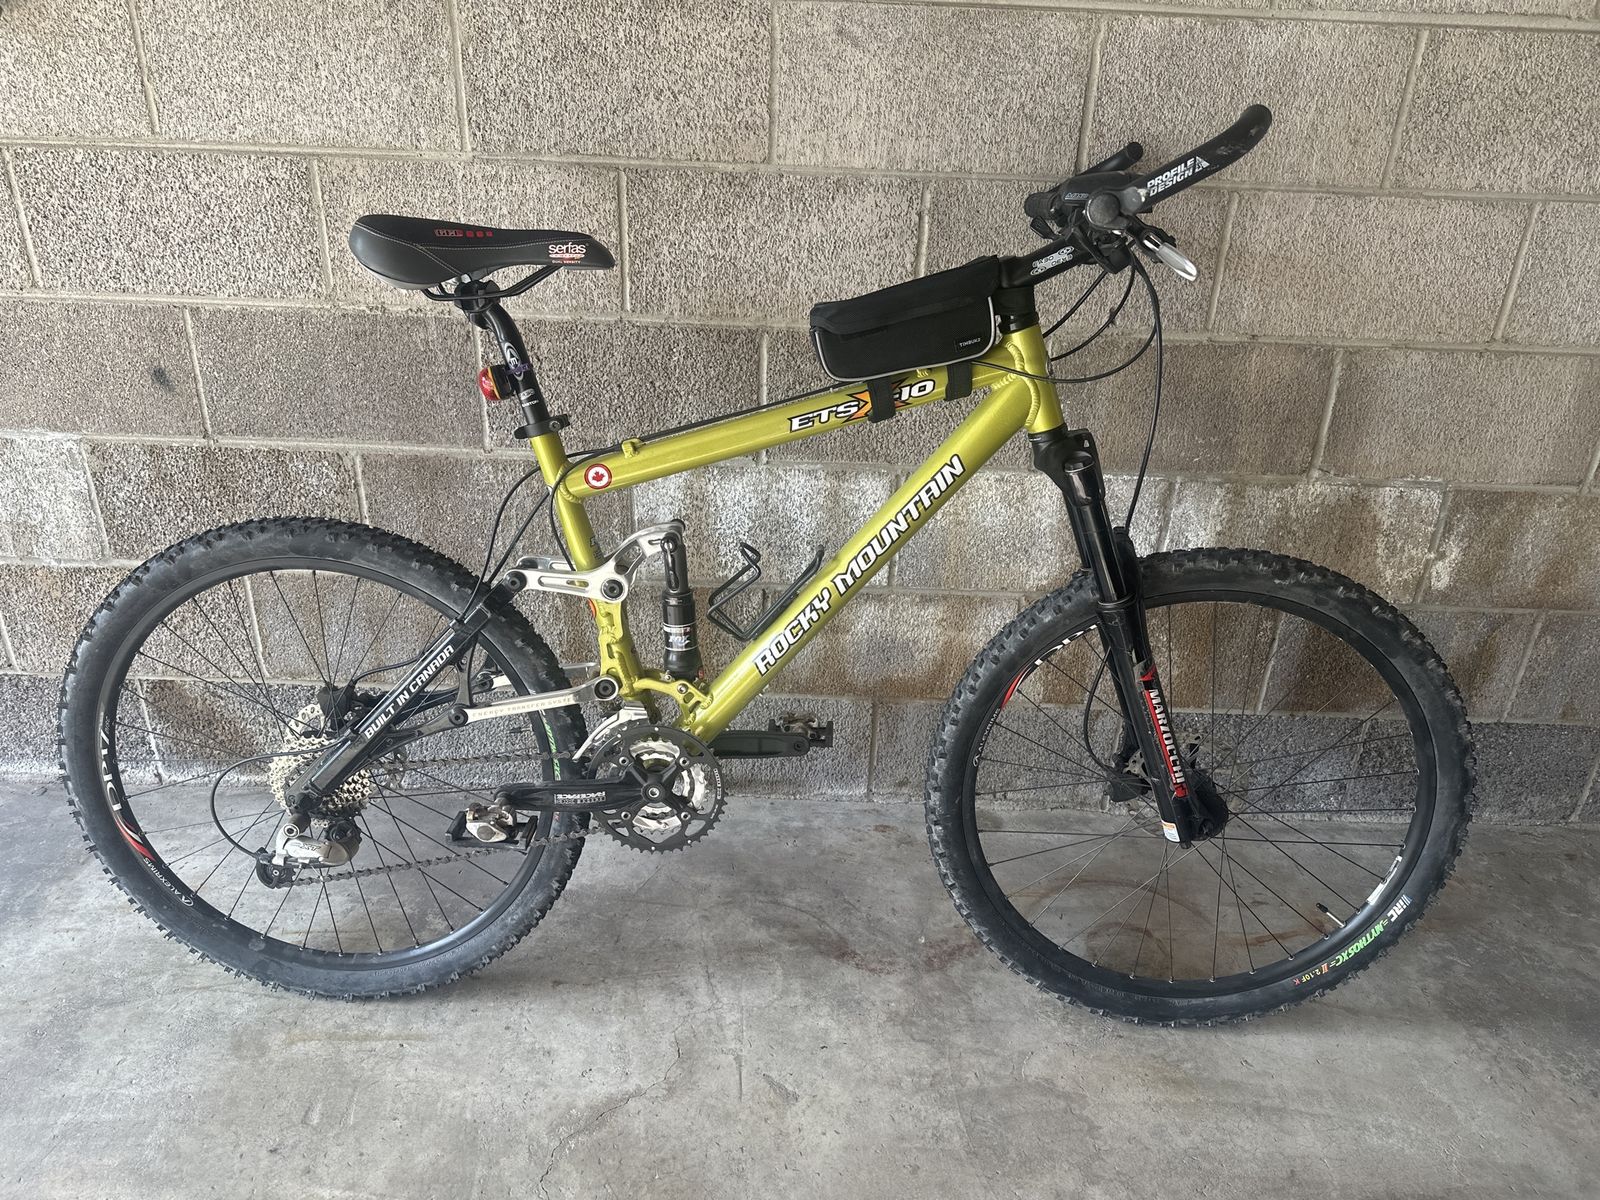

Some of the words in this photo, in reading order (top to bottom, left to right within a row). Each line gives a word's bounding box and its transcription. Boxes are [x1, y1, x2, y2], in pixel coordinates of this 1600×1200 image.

[1147, 157, 1195, 188] PROFILE
[1150, 167, 1193, 197] DESIGN
[548, 242, 587, 254] serfas
[754, 588, 831, 677] ROCKY
[831, 454, 966, 597] MOUNTAIN
[364, 703, 395, 739] BUILT
[396, 690, 410, 706] IN
[408, 645, 454, 693] CANADA
[1149, 689, 1185, 784] MARZOCCHI
[143, 856, 183, 898] ALEXRIMS
